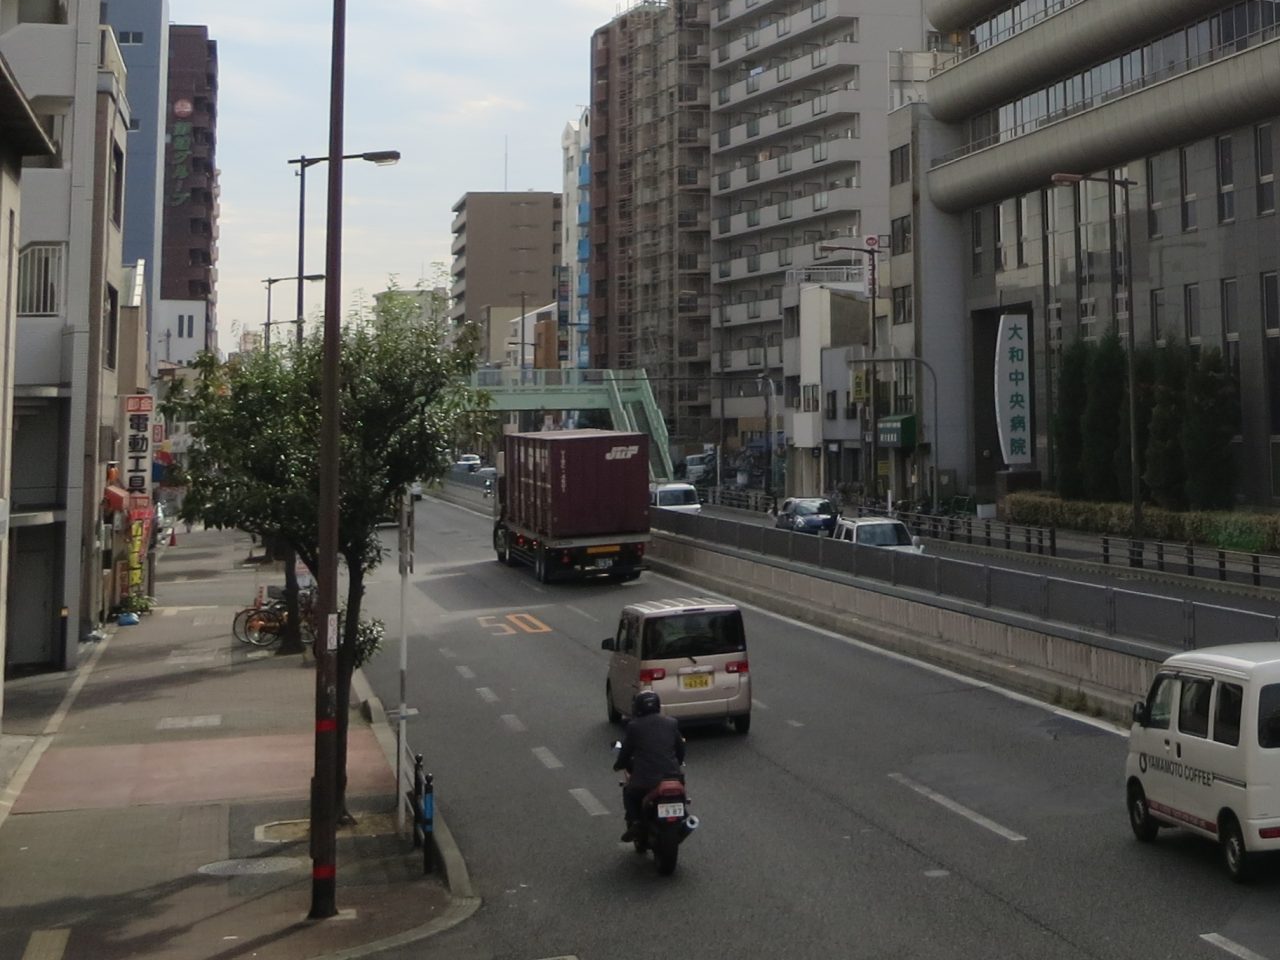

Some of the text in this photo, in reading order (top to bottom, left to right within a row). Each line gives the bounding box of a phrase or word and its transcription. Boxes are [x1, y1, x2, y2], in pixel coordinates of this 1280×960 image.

[1008, 323, 1027, 456] 大和中央病院
[126, 413, 150, 494] 電動工具
[477, 613, 553, 636] 50
[1147, 755, 1212, 787] YAMAMOTO COFFEE
